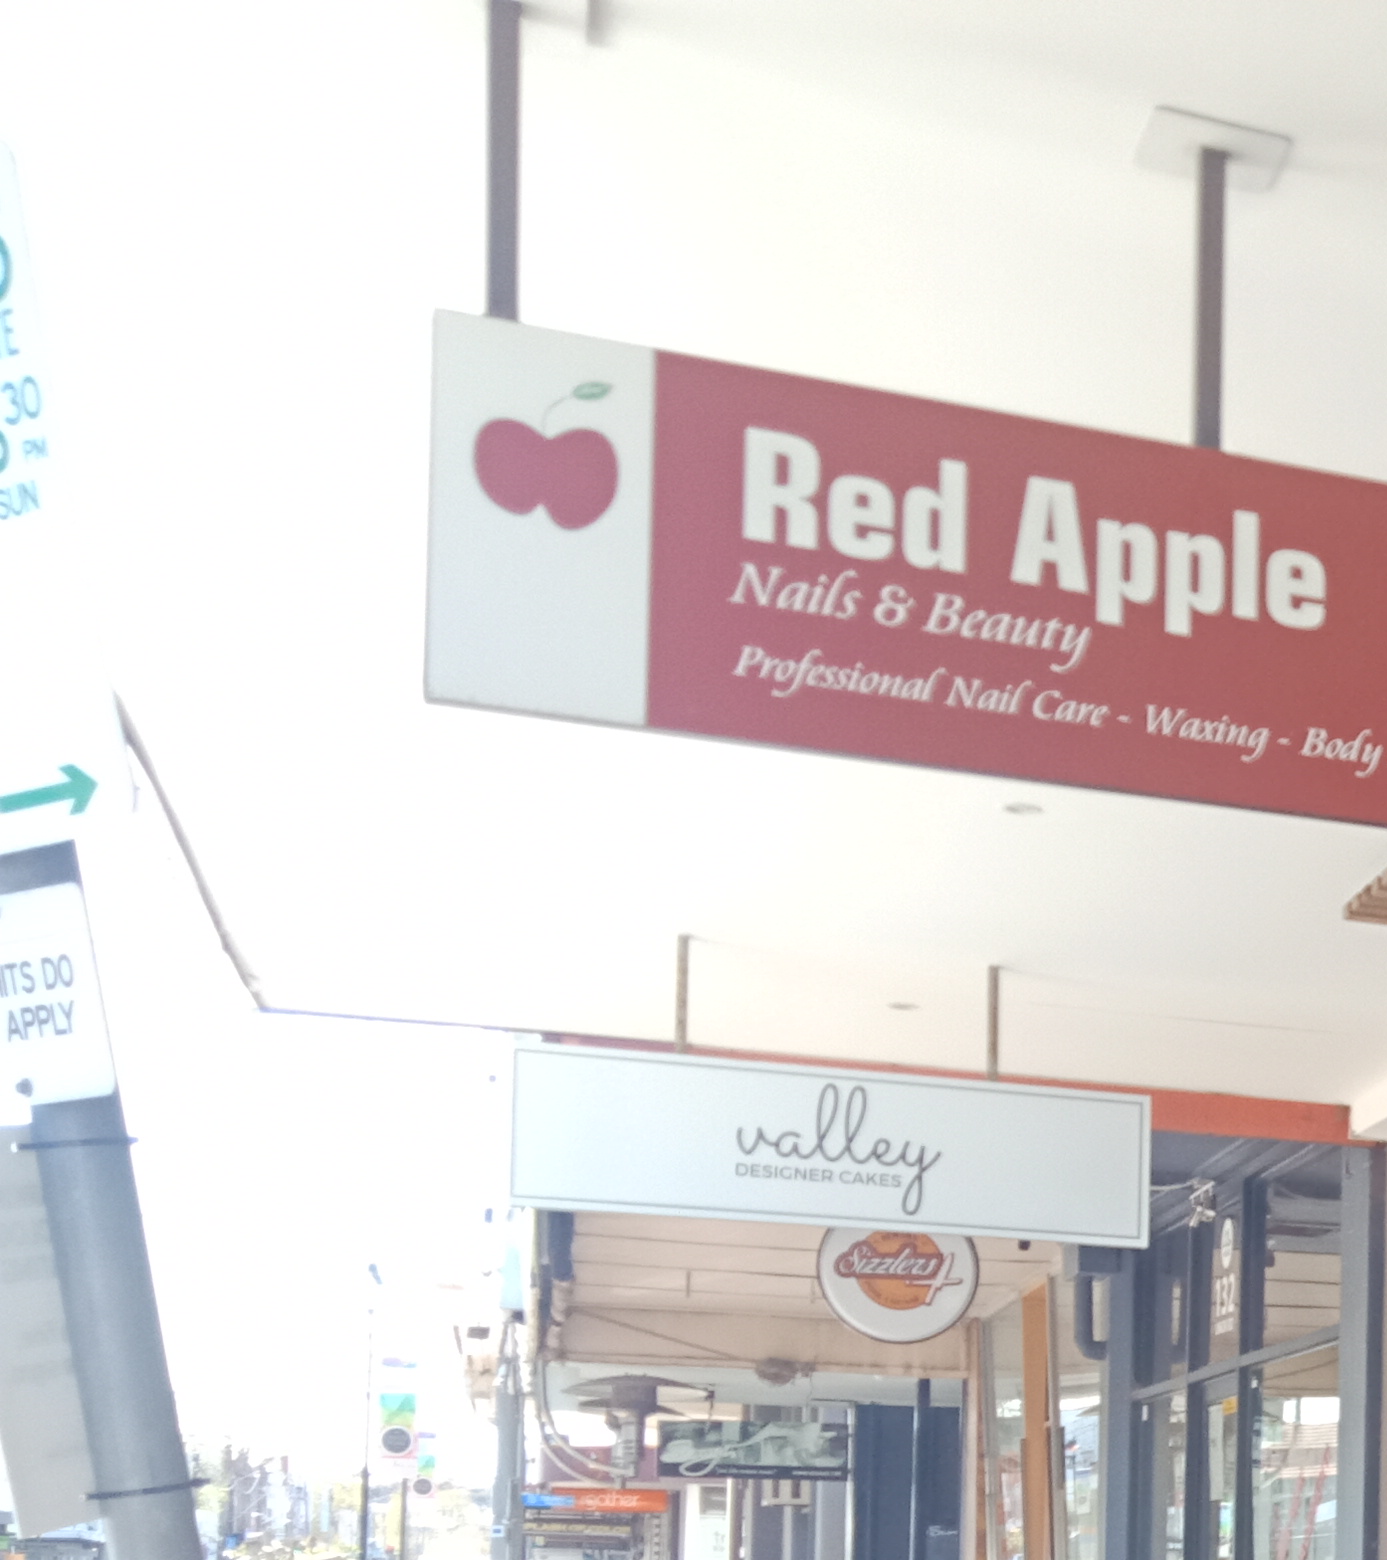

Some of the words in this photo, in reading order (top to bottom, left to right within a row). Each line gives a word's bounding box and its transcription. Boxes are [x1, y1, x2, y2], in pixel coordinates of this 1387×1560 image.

[742, 425, 967, 575] Red
[1009, 475, 1326, 637] Apple
[727, 561, 863, 620] Nails
[872, 583, 916, 628] &
[922, 592, 1092, 674] Beauty
[731, 645, 947, 698] Professional
[944, 675, 1033, 715] Nail
[1033, 690, 1111, 727] Care
[1145, 703, 1271, 763] Waxing
[1299, 726, 1383, 778] Body
[40, 953, 74, 991] DO
[8, 1000, 75, 1043] APPLY
[736, 1083, 942, 1215] valley
[735, 1162, 834, 1182] DESIGNER
[838, 1170, 903, 1188] CAKES
[838, 1243, 938, 1275] Sizzlers
[1214, 1272, 1236, 1318] 132
